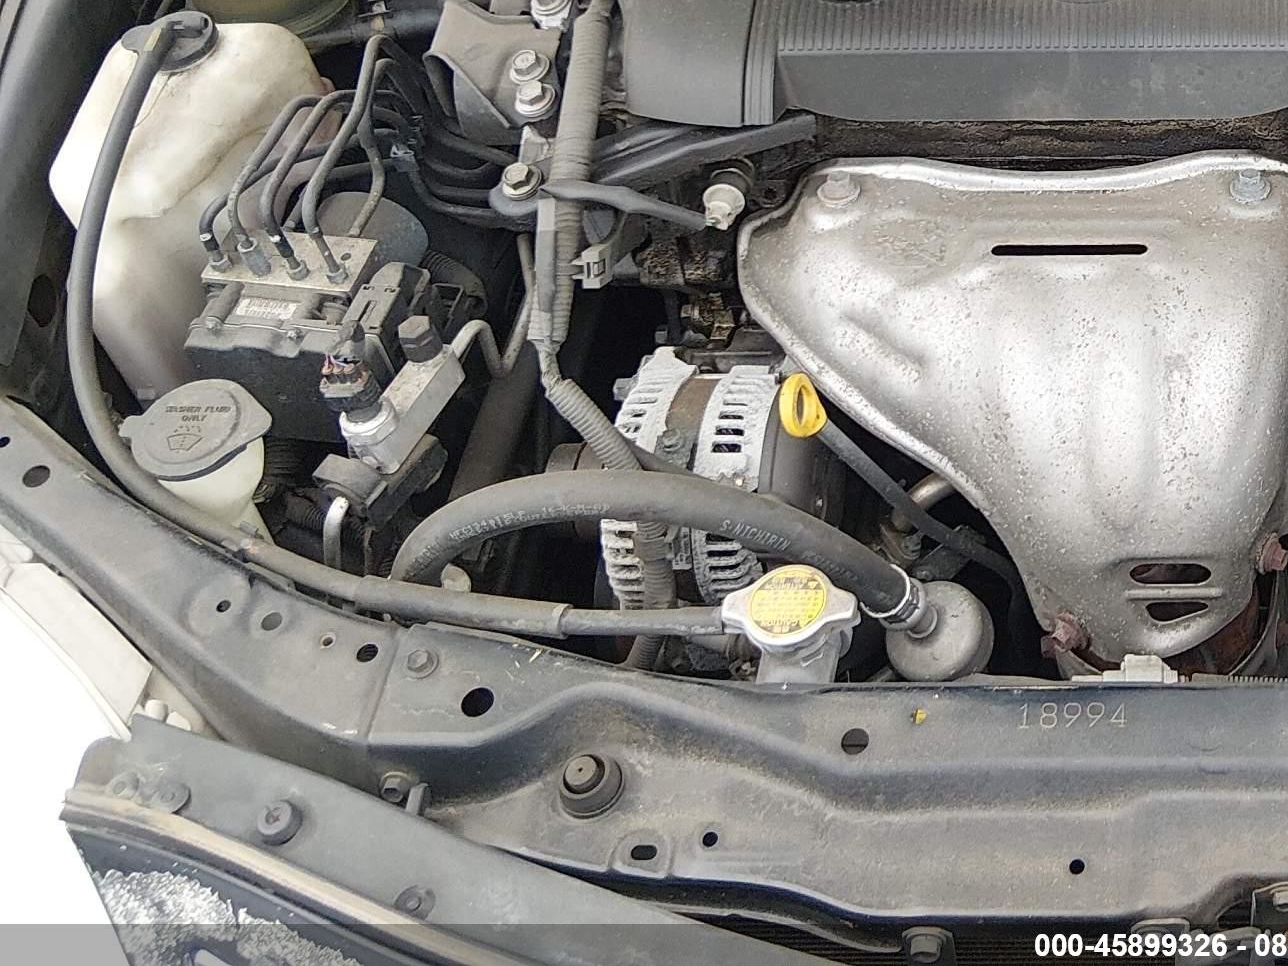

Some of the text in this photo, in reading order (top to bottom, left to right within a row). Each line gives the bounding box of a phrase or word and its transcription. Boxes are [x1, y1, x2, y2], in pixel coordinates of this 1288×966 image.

[165, 405, 232, 413] WASHER FLUID
[181, 414, 207, 422] ONLY
[1019, 701, 1128, 729] 18994
